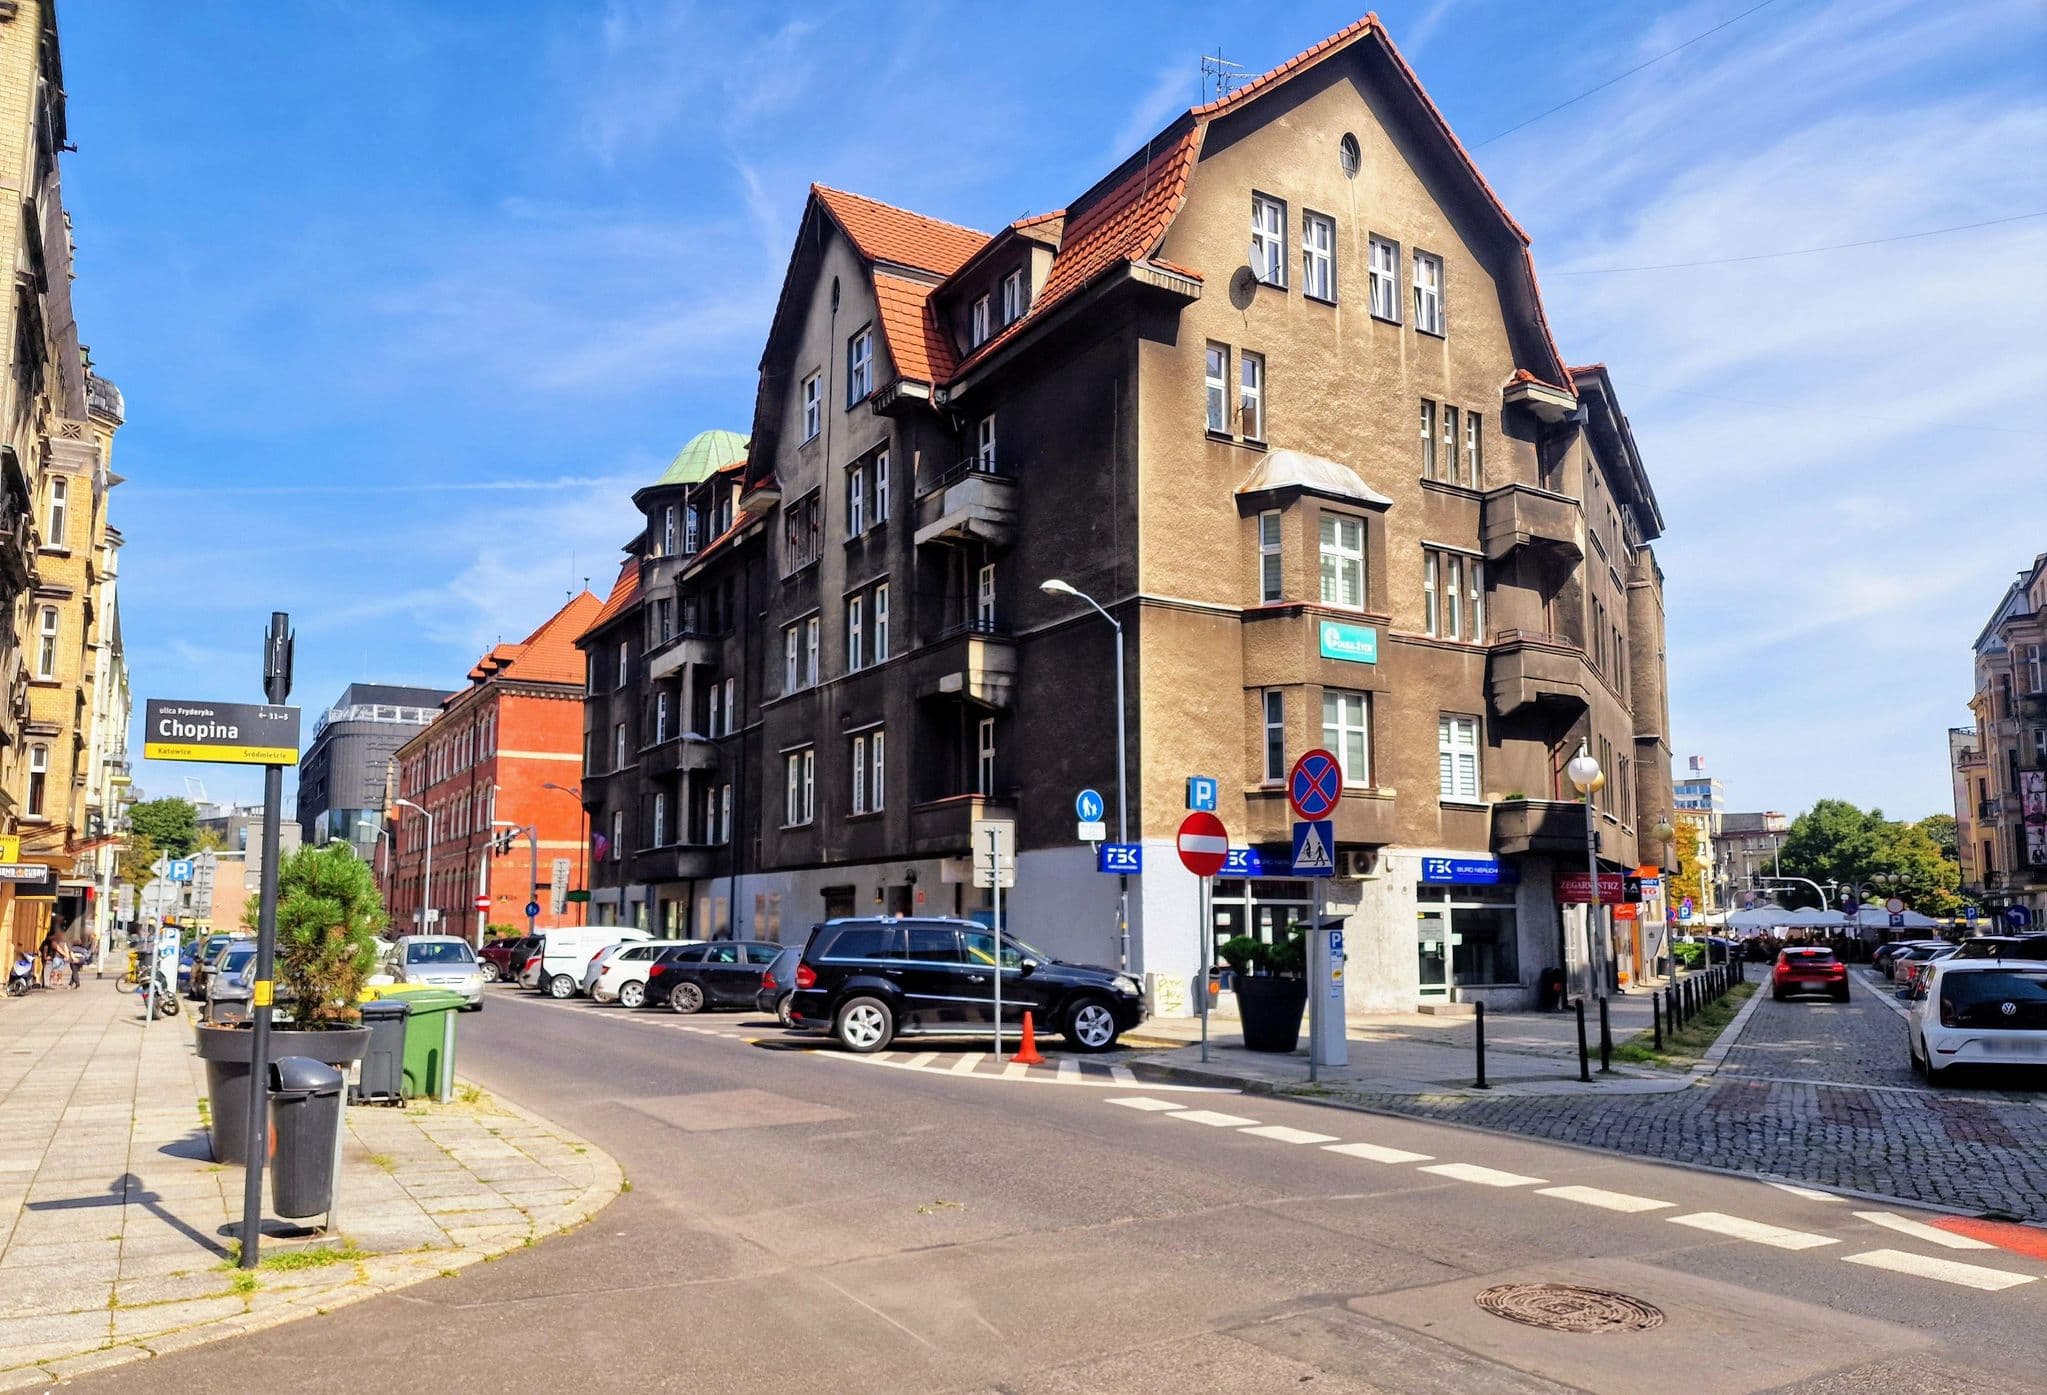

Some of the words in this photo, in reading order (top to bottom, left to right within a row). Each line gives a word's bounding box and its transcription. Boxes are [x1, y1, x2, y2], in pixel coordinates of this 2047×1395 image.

[159, 707, 177, 715] ulica
[177, 707, 214, 717] Fryderyka
[159, 719, 239, 741] Chopina
[1196, 781, 1211, 806] P
[1228, 851, 1248, 866] SK
[174, 863, 188, 877] P
[1560, 880, 1619, 890] ZEGARMSTRZ
[1331, 933, 1342, 948] P
